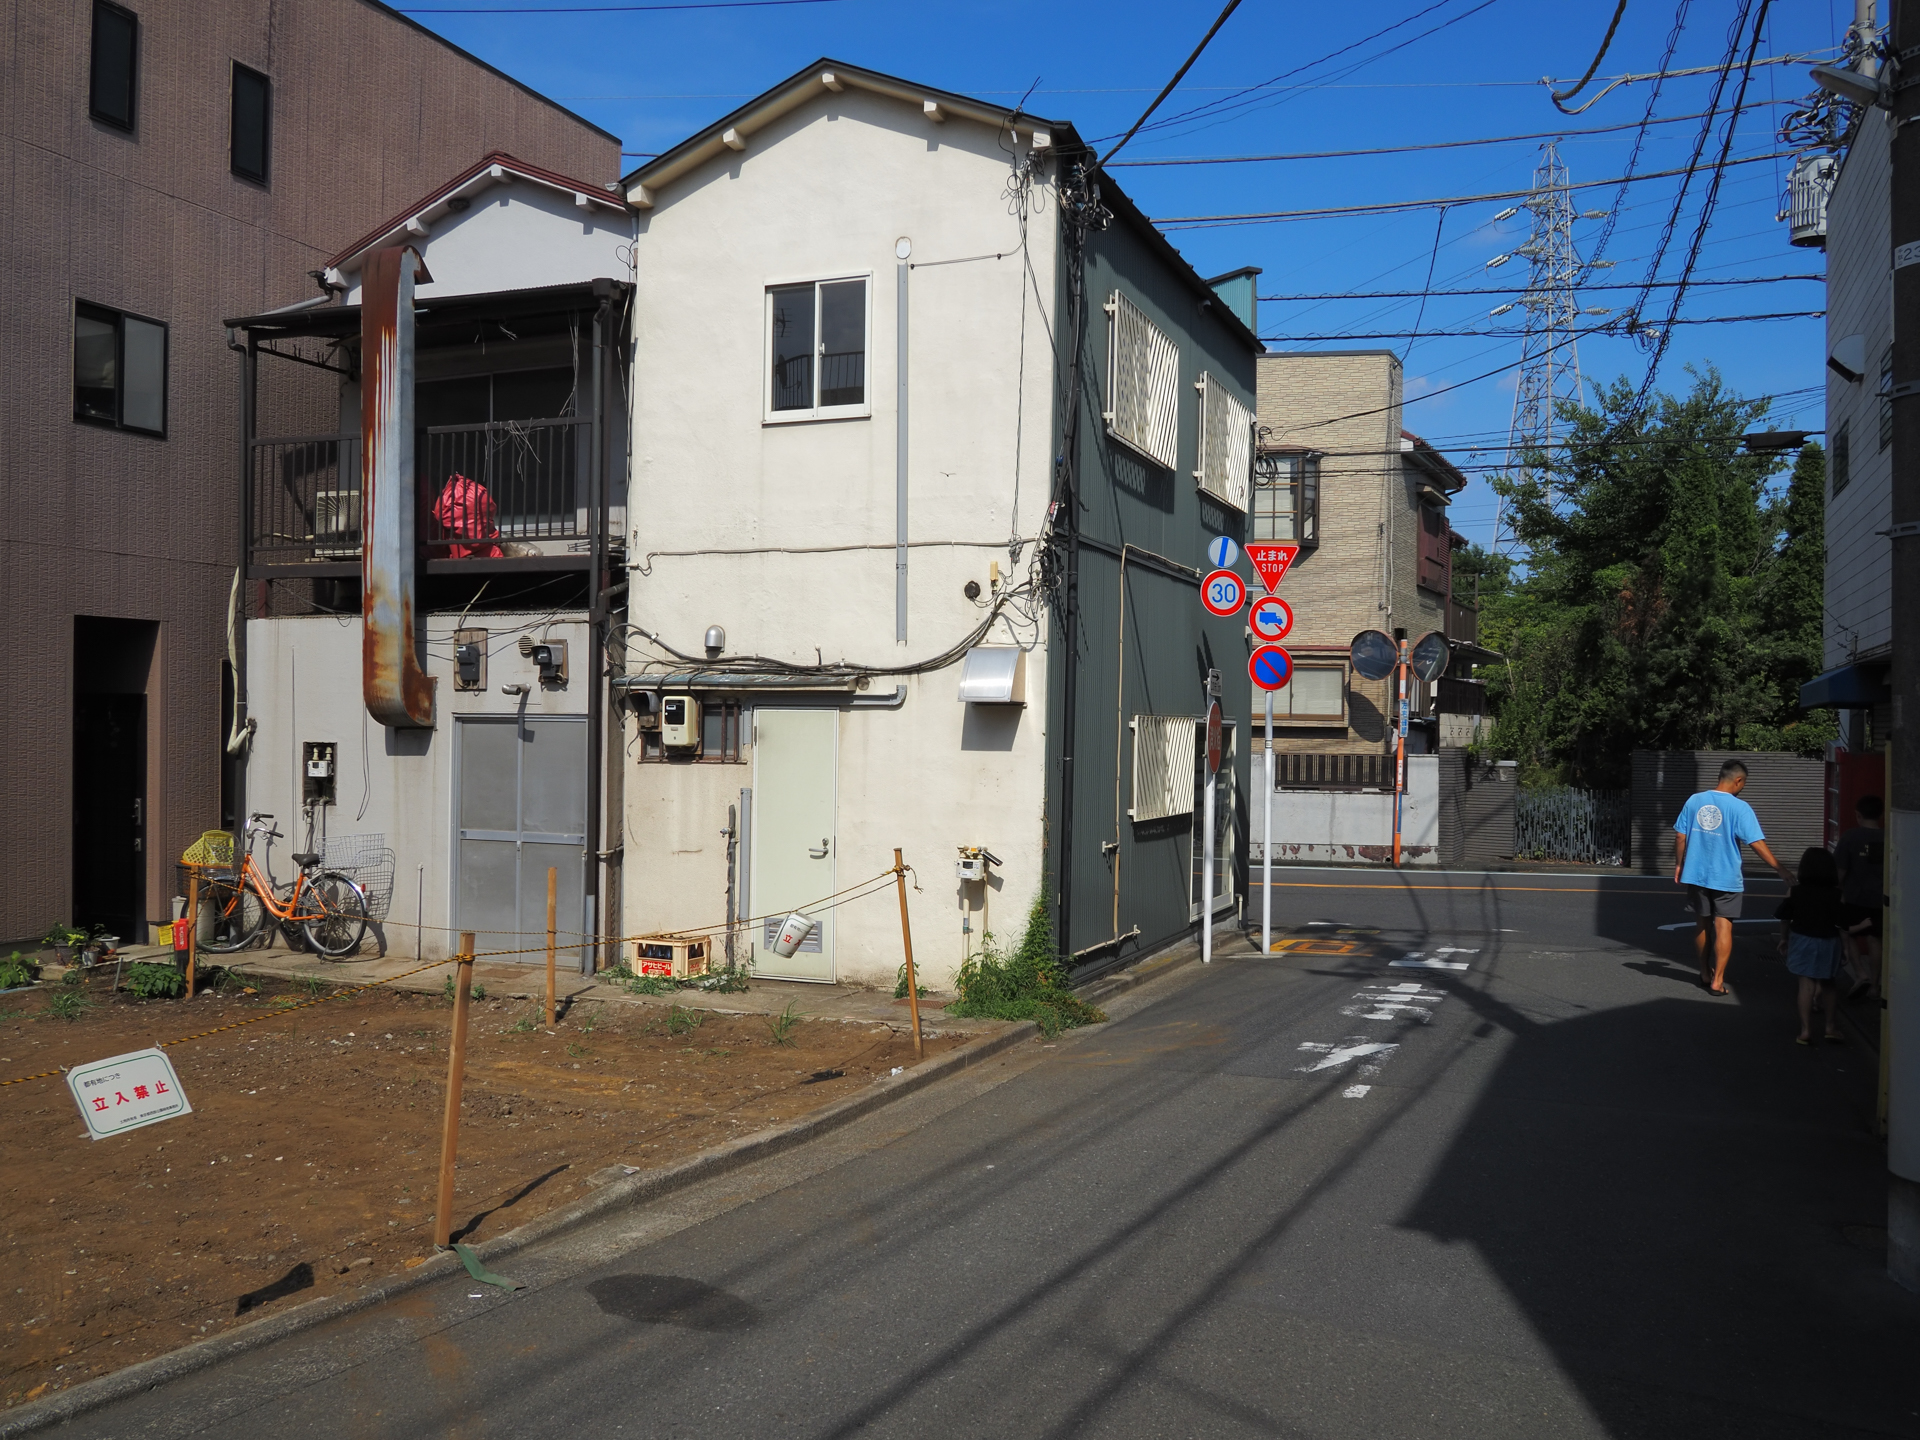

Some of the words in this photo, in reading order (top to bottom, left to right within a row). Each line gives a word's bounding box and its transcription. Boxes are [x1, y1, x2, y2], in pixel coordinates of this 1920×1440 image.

[1256, 549, 1288, 561] 止まれ
[1261, 563, 1284, 573] STOP
[1212, 583, 1236, 603] 30
[642, 961, 671, 970] アサヒビール
[84, 1073, 121, 1088] 都有地につき
[92, 1080, 169, 1112] 立入禁止
